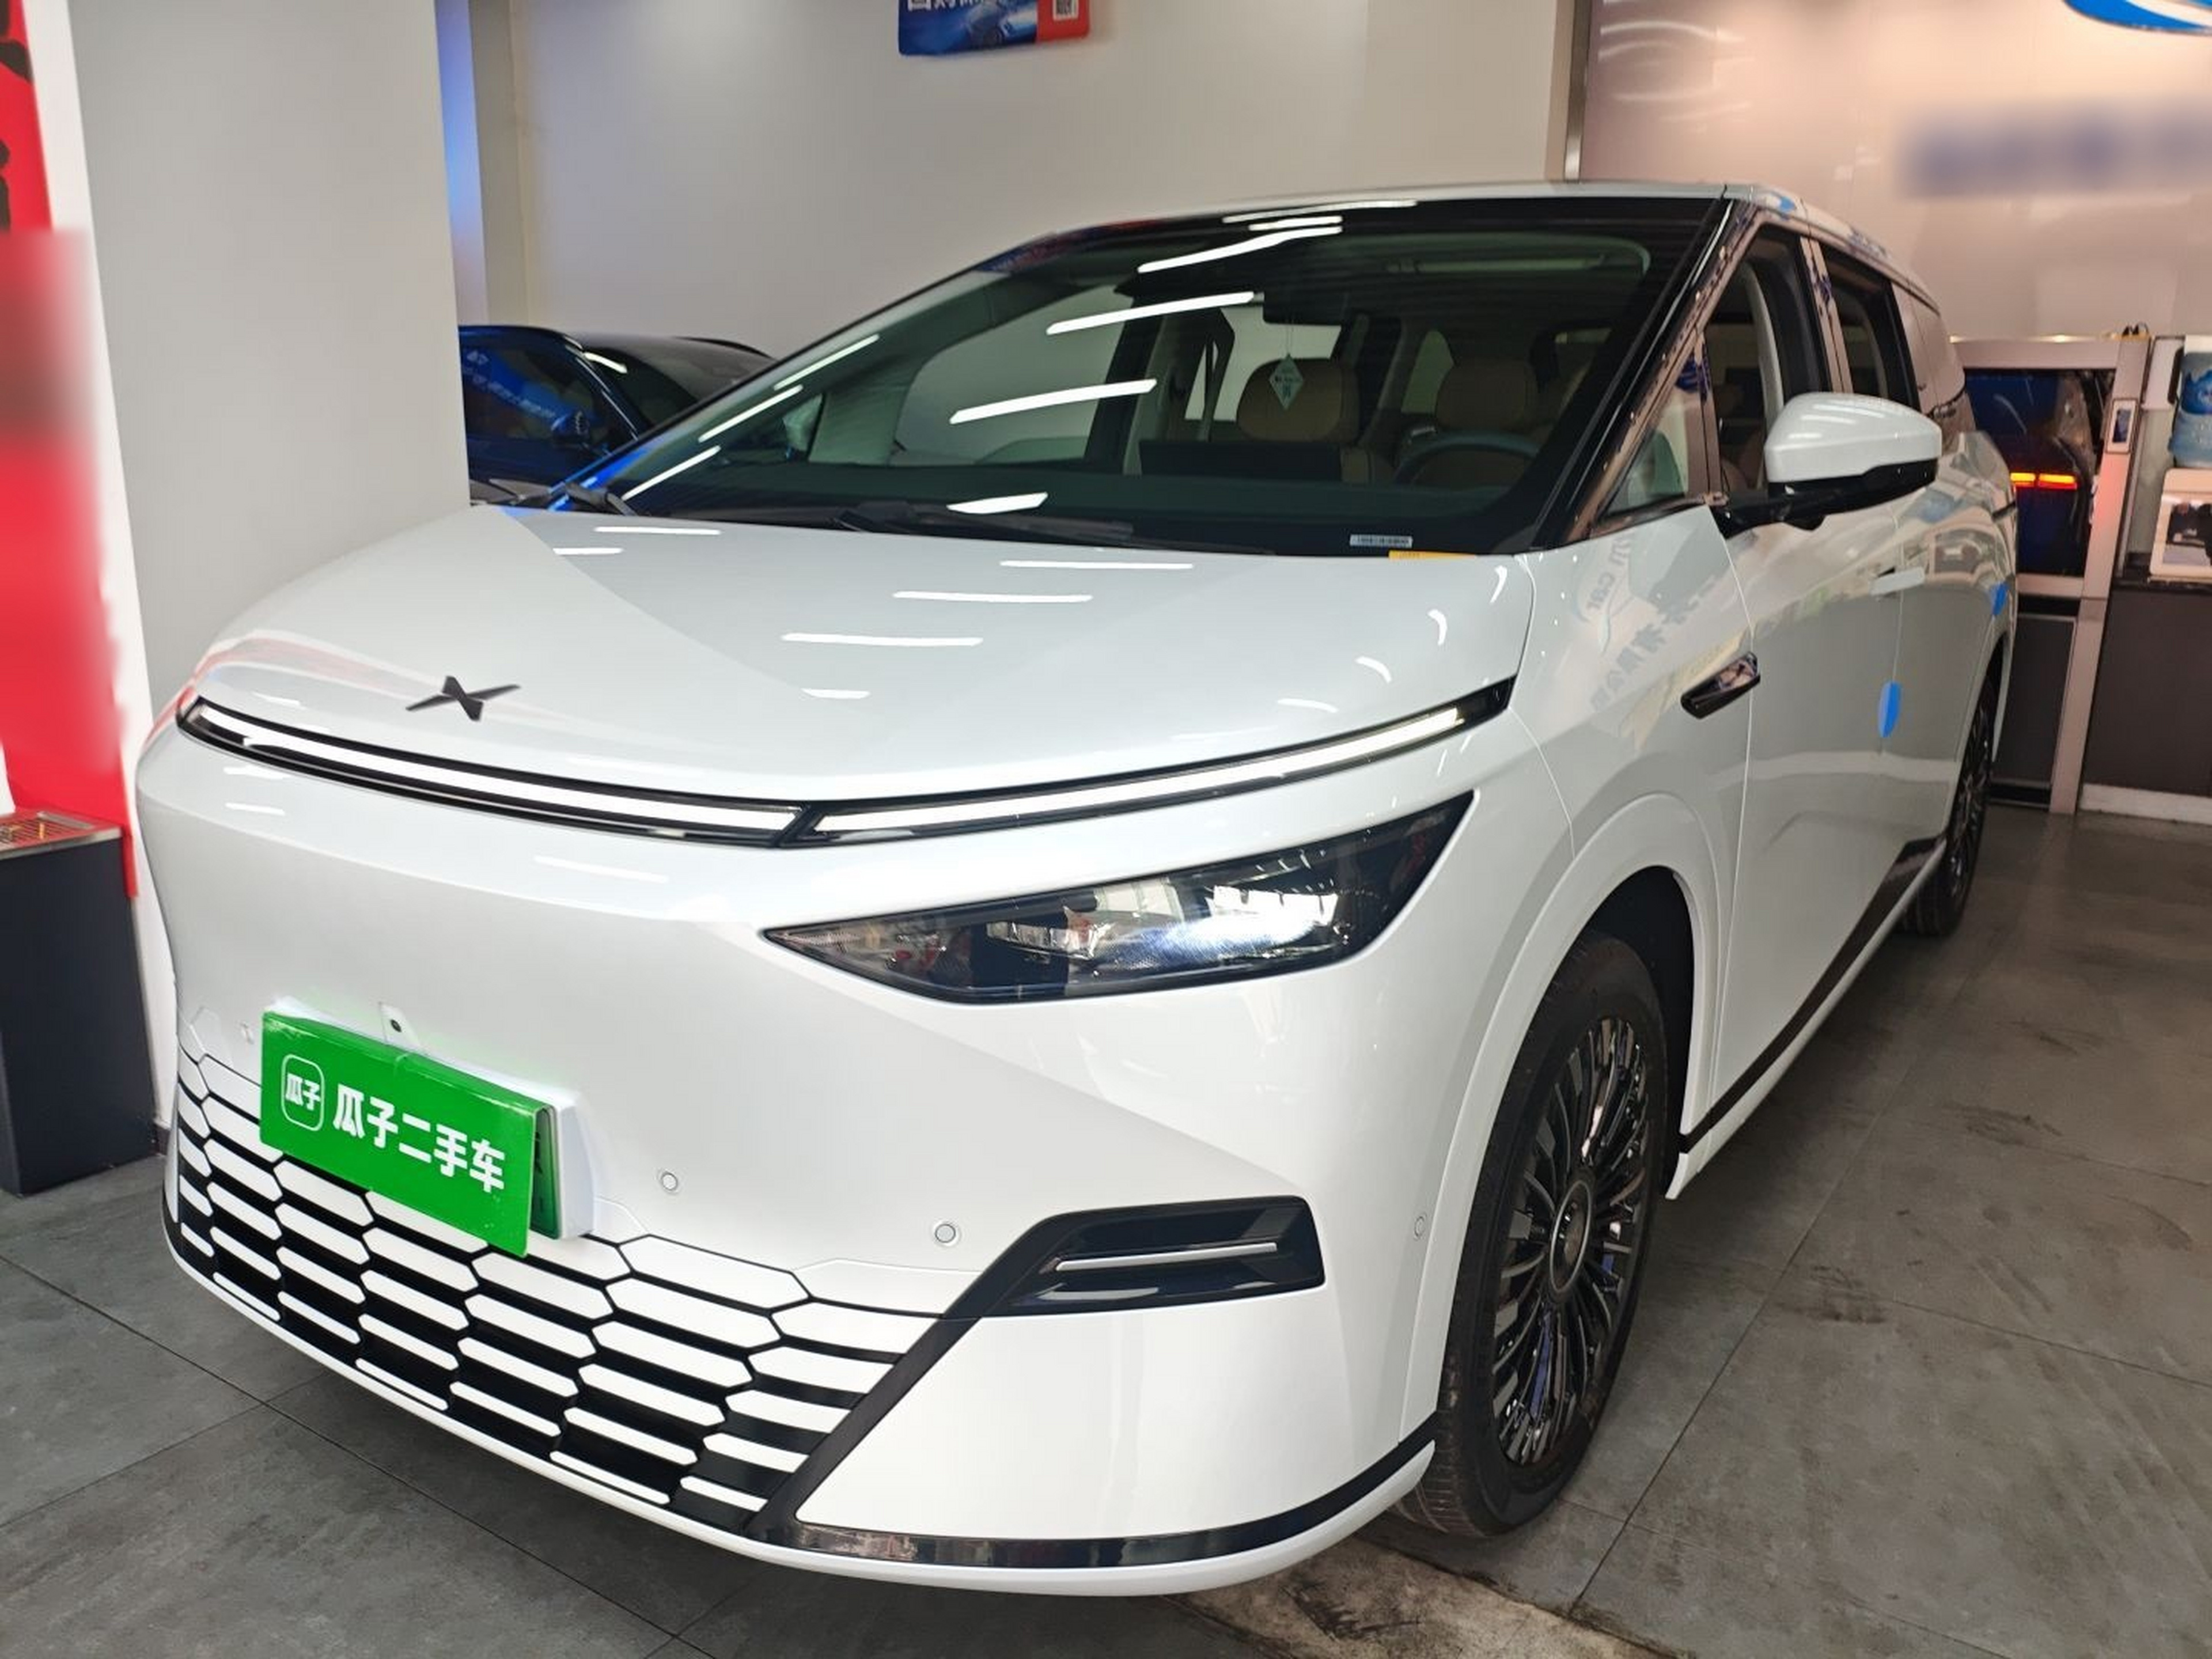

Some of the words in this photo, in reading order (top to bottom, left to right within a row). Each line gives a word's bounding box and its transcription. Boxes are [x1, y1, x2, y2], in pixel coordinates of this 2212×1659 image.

[285, 1073, 320, 1111] 瓜子
[333, 1084, 505, 1192] 瓜子二手车
